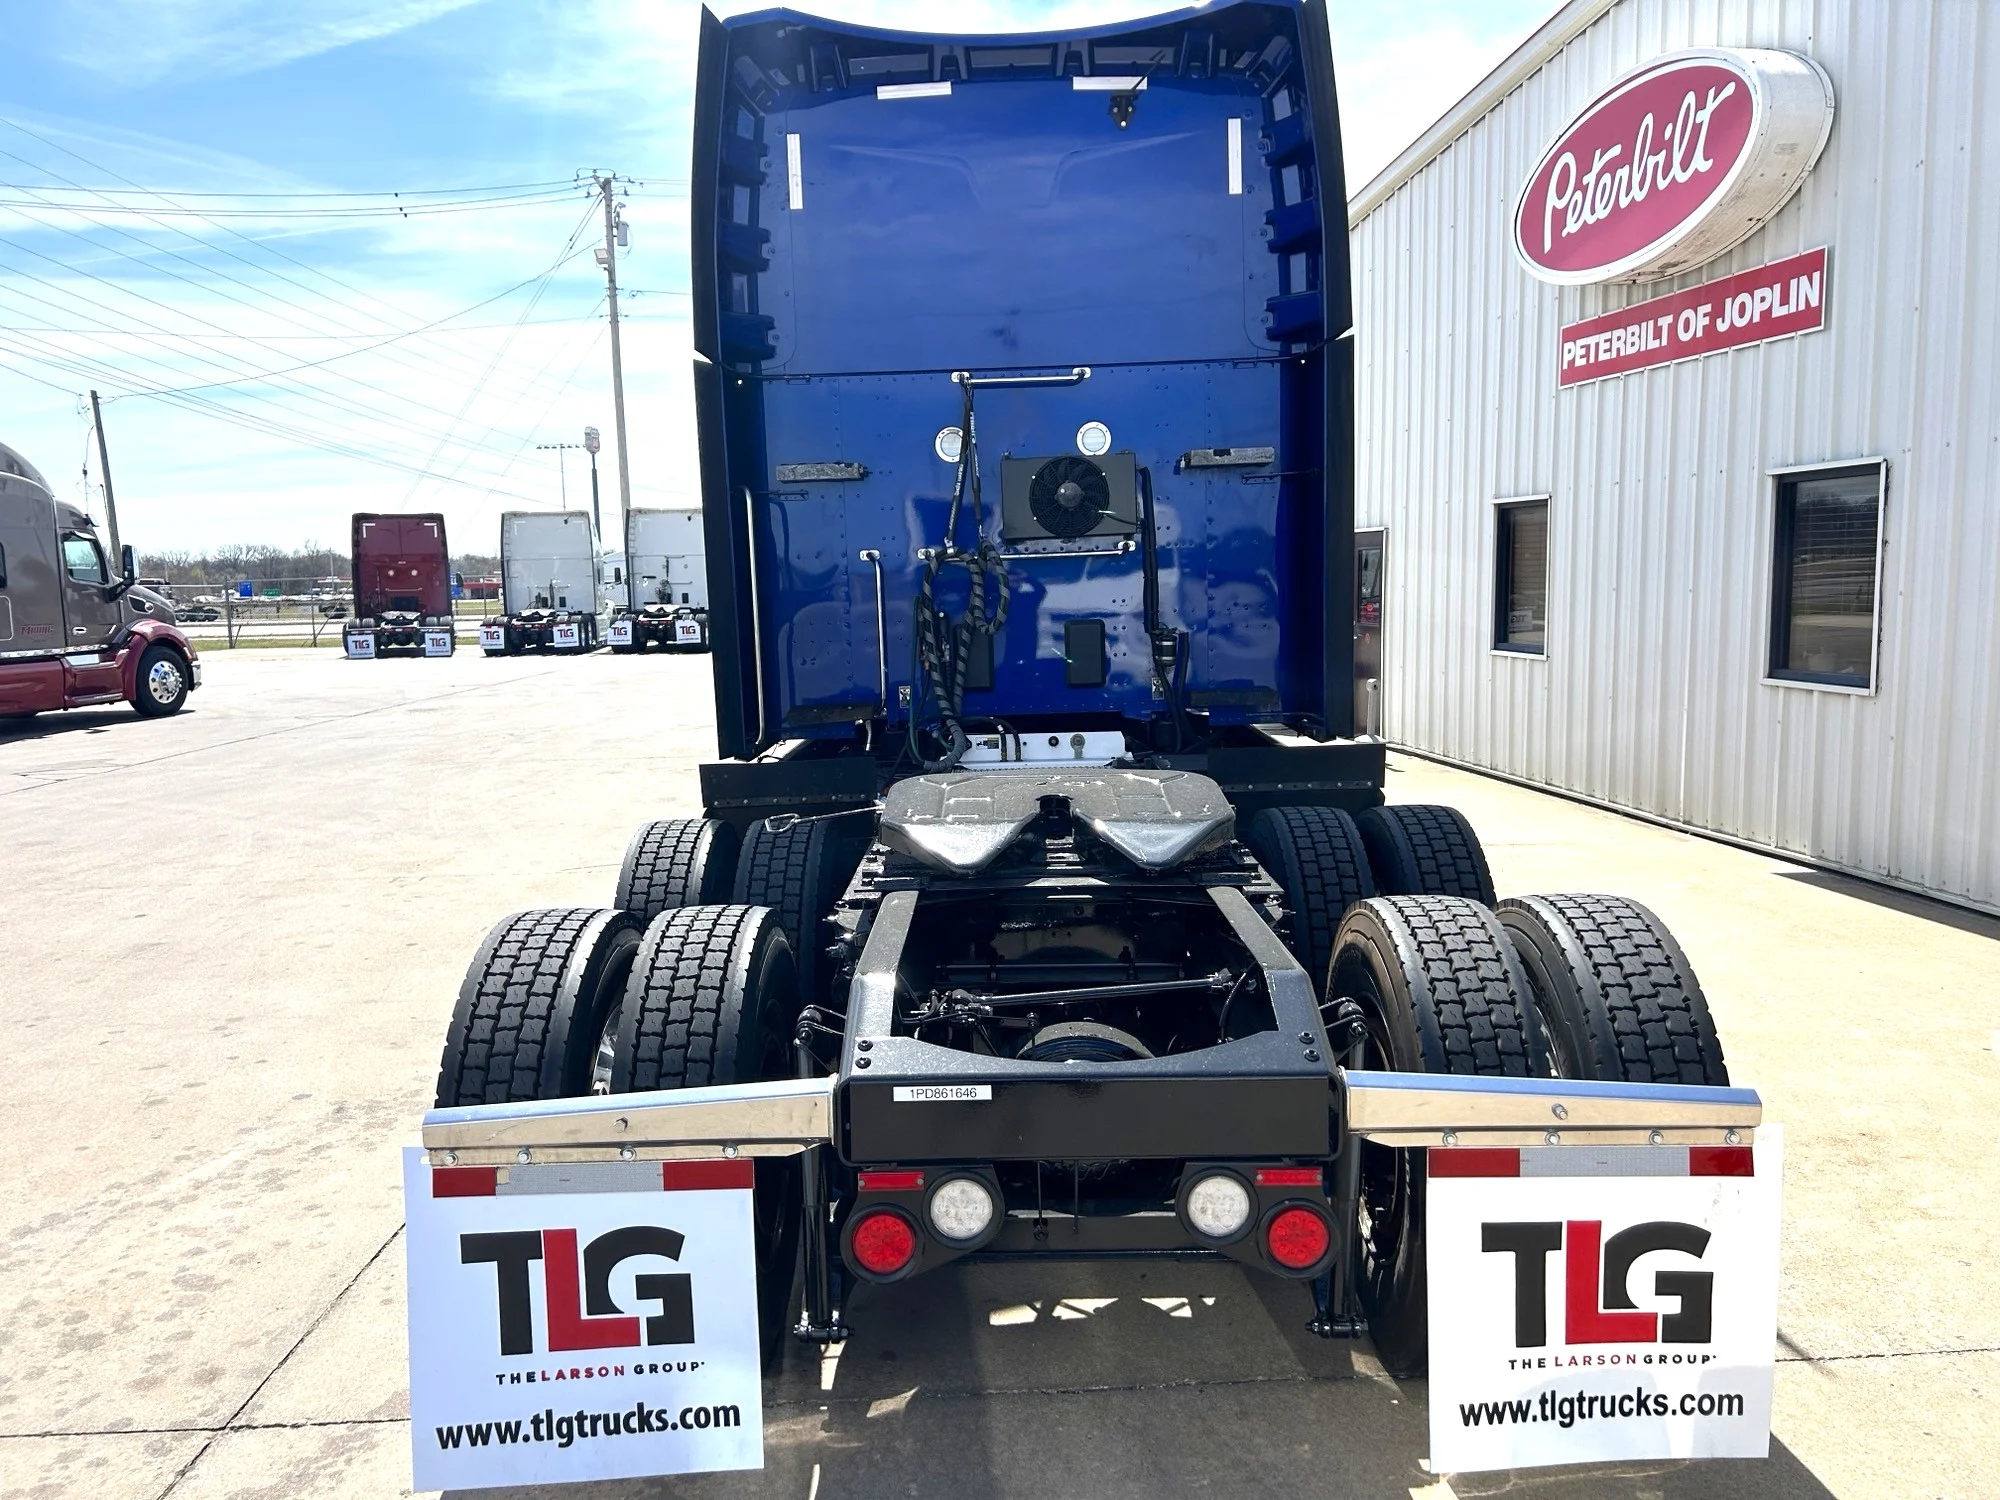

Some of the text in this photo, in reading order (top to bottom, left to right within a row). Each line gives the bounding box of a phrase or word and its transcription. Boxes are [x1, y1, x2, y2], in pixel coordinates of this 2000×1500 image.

[1543, 81, 1736, 254] Peterbilt
[1562, 270, 1821, 370] PETERBILT OF JOPLIN
[484, 630, 501, 640] TLG
[557, 628, 575, 638] TLG
[609, 626, 628, 636] TLG
[679, 625, 697, 635] TLG
[352, 639, 370, 650] TLG
[429, 637, 447, 648] TLG
[909, 1087, 978, 1099] 1PD861646
[460, 1225, 695, 1356] TLG
[1481, 1220, 1714, 1348] TLG
[1508, 1358, 1547, 1370] THE
[1554, 1354, 1637, 1367] LARSON
[541, 1365, 625, 1382] LARSON
[1459, 1386, 1744, 1428] www.tlgtrucks.com
[435, 1401, 741, 1450] www.tlgtrucks.com
